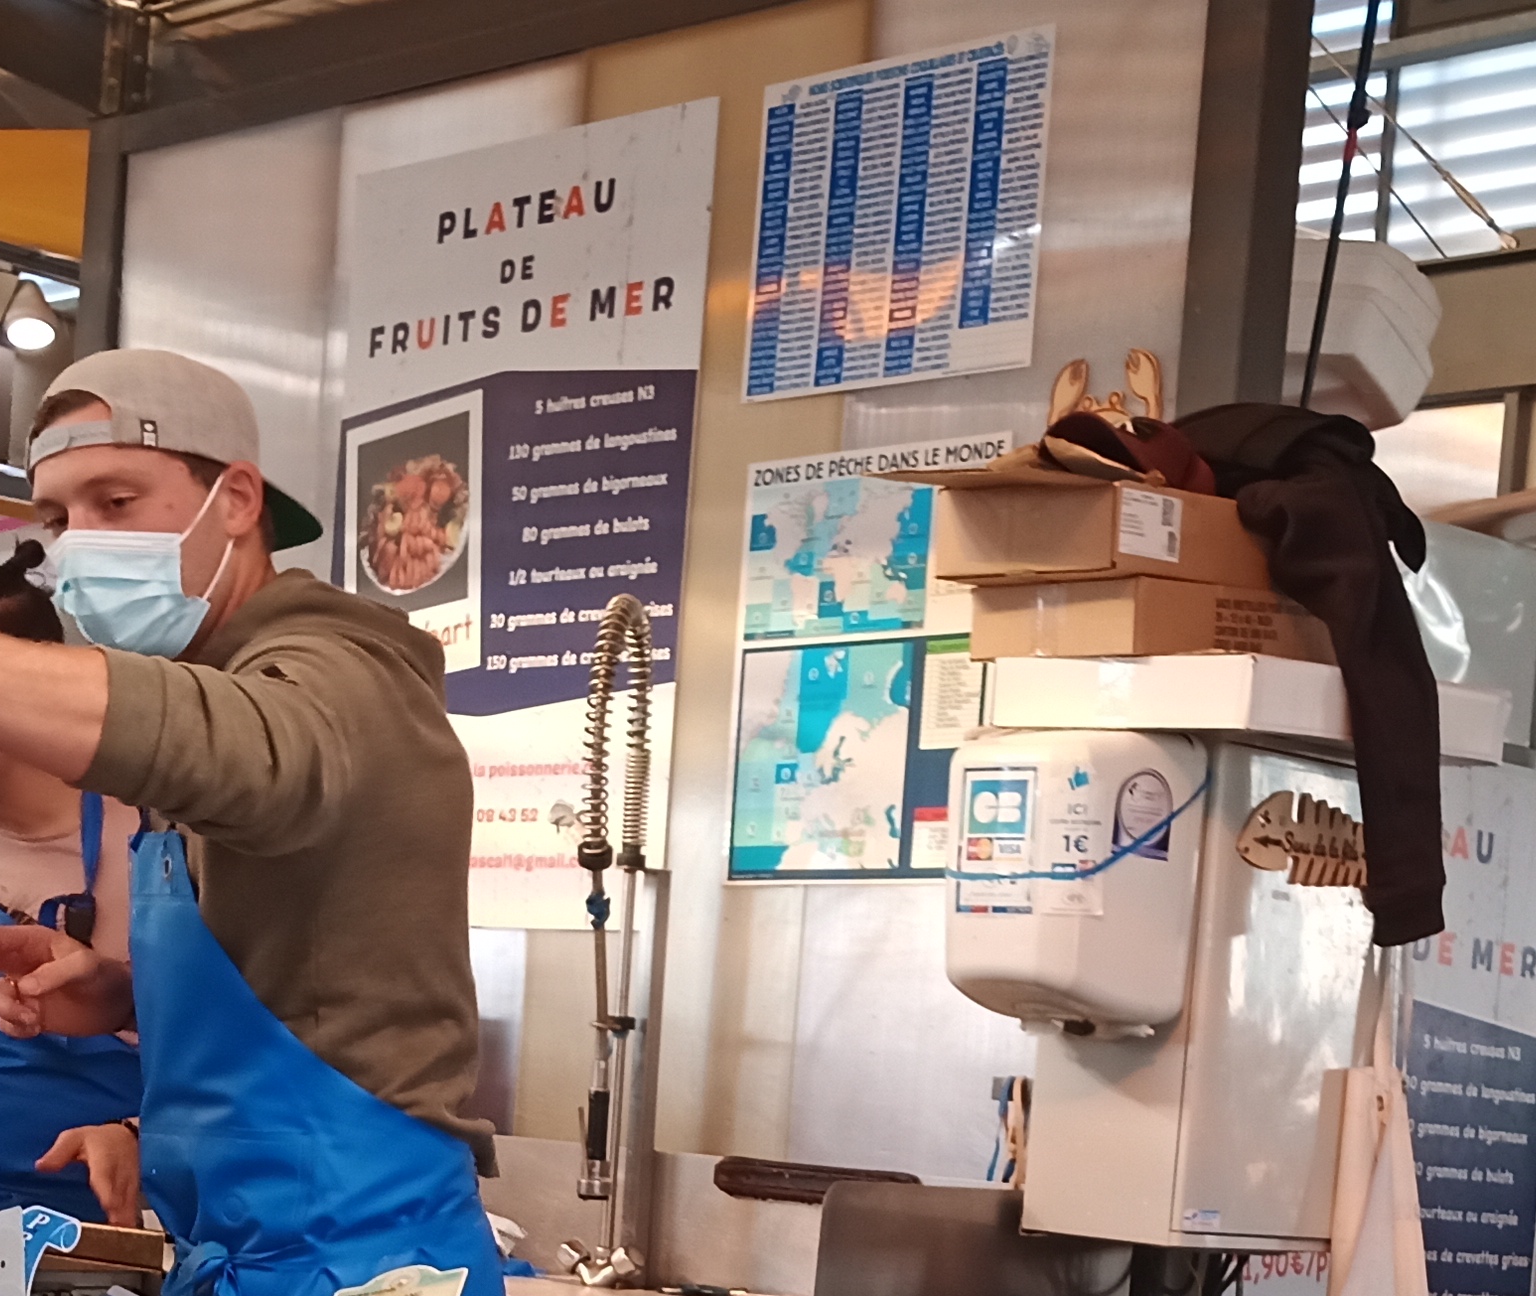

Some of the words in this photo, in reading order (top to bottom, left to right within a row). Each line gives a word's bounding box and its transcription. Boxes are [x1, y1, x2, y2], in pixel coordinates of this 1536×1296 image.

[437, 178, 616, 244] PLATEAU
[500, 255, 535, 284] DE
[369, 306, 500, 358] FRUITS
[521, 293, 570, 333] DE
[589, 276, 675, 322] MER
[585, 434, 601, 450] de
[754, 464, 801, 487] ZONES
[805, 461, 824, 480] DE
[828, 455, 873, 478] PÊCHE
[878, 449, 919, 471] DANS
[924, 447, 940, 466] LE
[945, 439, 1006, 464] MONDE
[583, 477, 598, 493] de
[594, 519, 610, 535] de
[559, 608, 575, 624] de
[561, 650, 577, 666] de
[1471, 938, 1536, 979] MER
[1420, 1205, 1463, 1221] ourteaux
